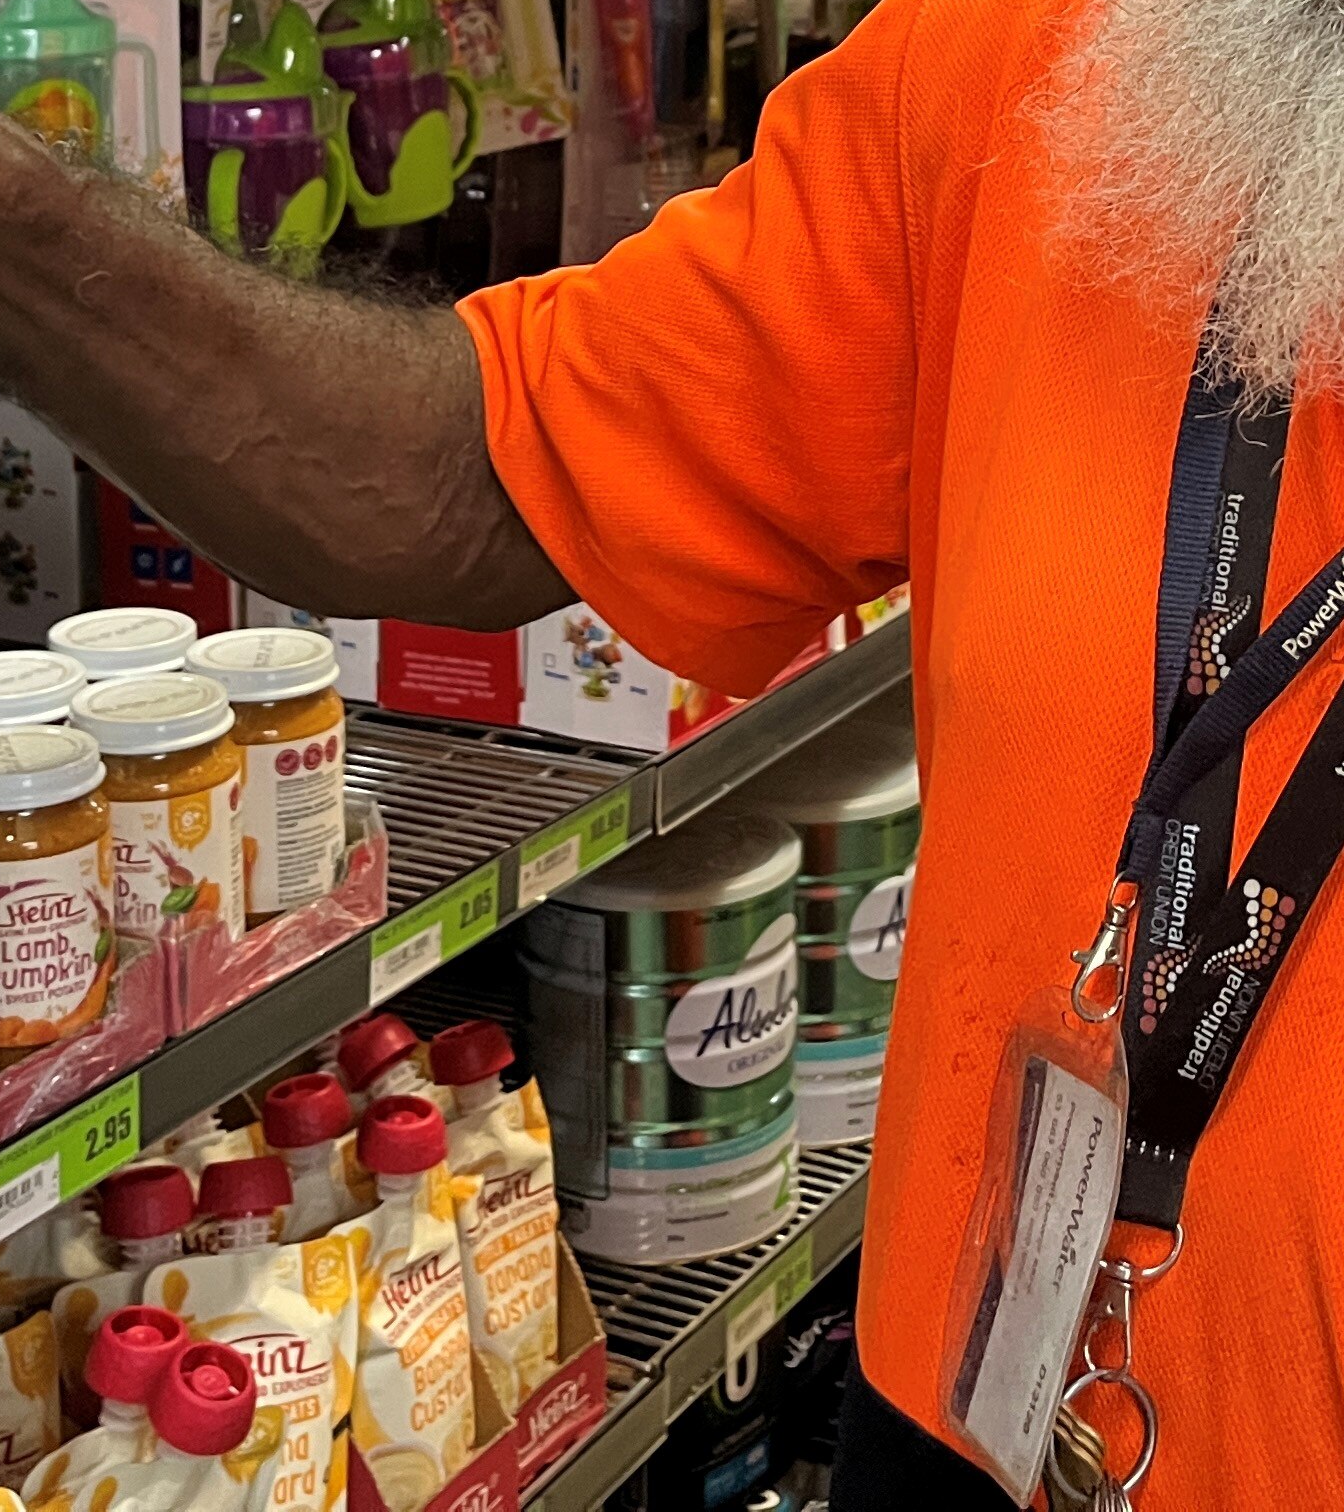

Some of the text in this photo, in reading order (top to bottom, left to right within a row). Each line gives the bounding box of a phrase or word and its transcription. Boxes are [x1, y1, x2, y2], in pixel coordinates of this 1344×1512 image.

[1211, 492, 1245, 613] traditional
[1149, 818, 1182, 947] CREDIT UNION
[1167, 823, 1201, 951] traditional
[1, 932, 77, 964] Lamb,
[1177, 964, 1246, 1081] traditional
[1197, 975, 1261, 1090] CREDIT UNION
[85, 1106, 131, 1163] 2.95
[382, 1254, 462, 1331] Heinz
